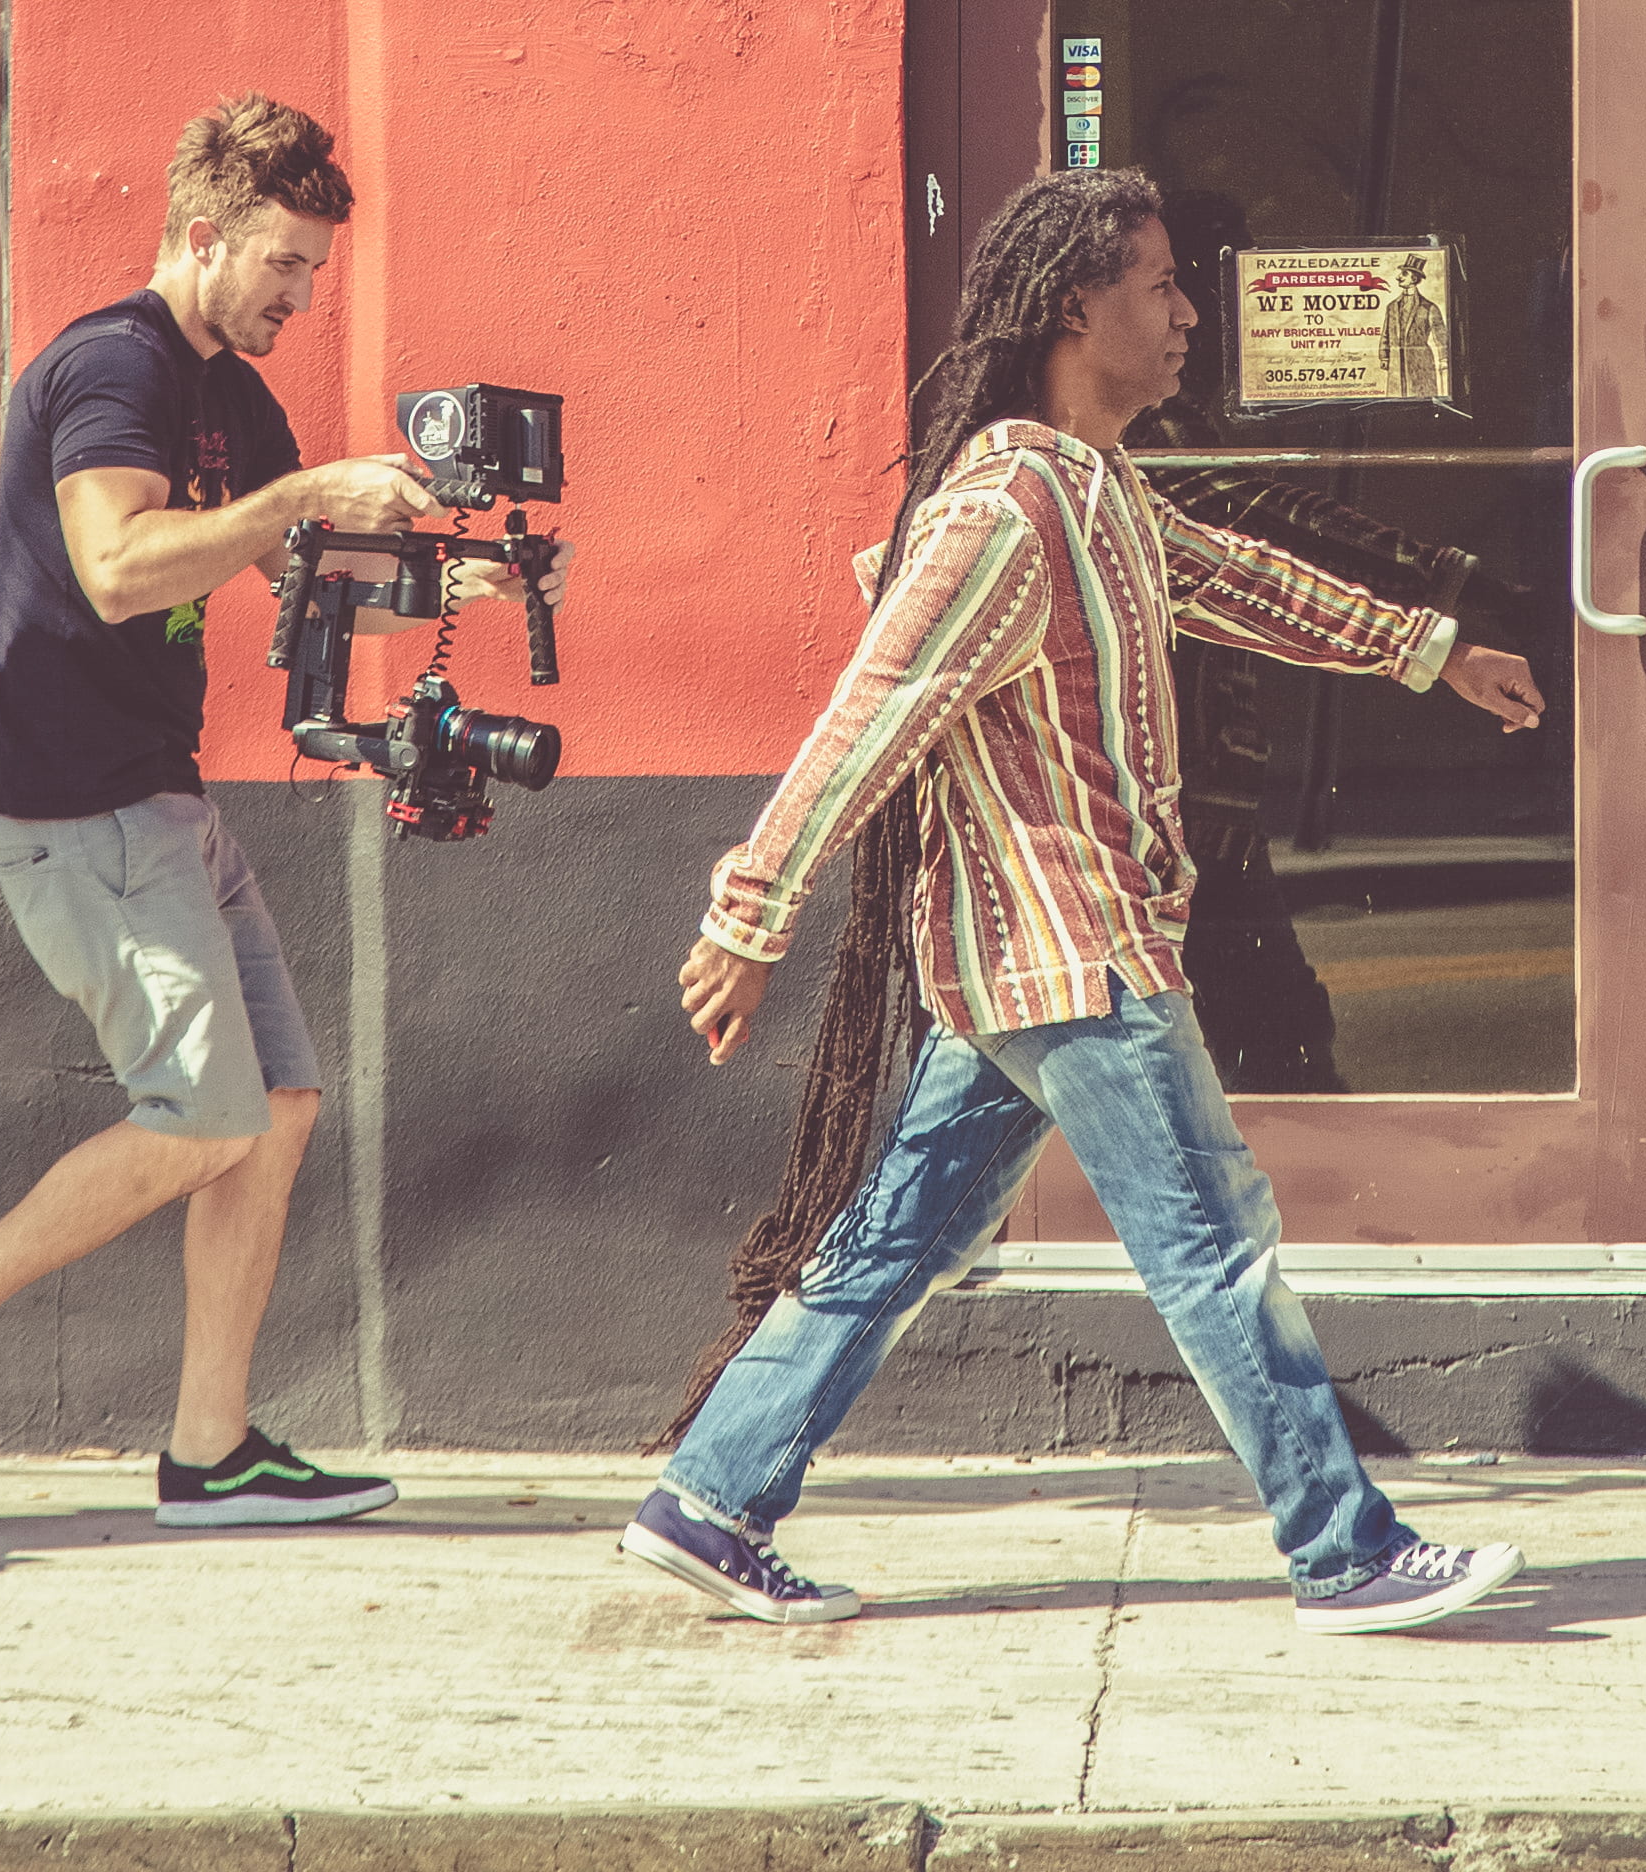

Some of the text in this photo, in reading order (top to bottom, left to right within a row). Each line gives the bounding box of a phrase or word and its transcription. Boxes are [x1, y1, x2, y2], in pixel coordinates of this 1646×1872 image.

[1068, 45, 1100, 57] VISA
[1256, 258, 1381, 269] RAZZLEDAZZLE
[1271, 274, 1365, 285] BARBERSHOP
[1257, 293, 1381, 312] WE MOVED
[1304, 314, 1324, 325] TO
[1250, 326, 1381, 338] MARY BRICKELL VILLAGE
[1290, 339, 1342, 349] UNIT #177
[1265, 367, 1367, 383] 305.579.4747
